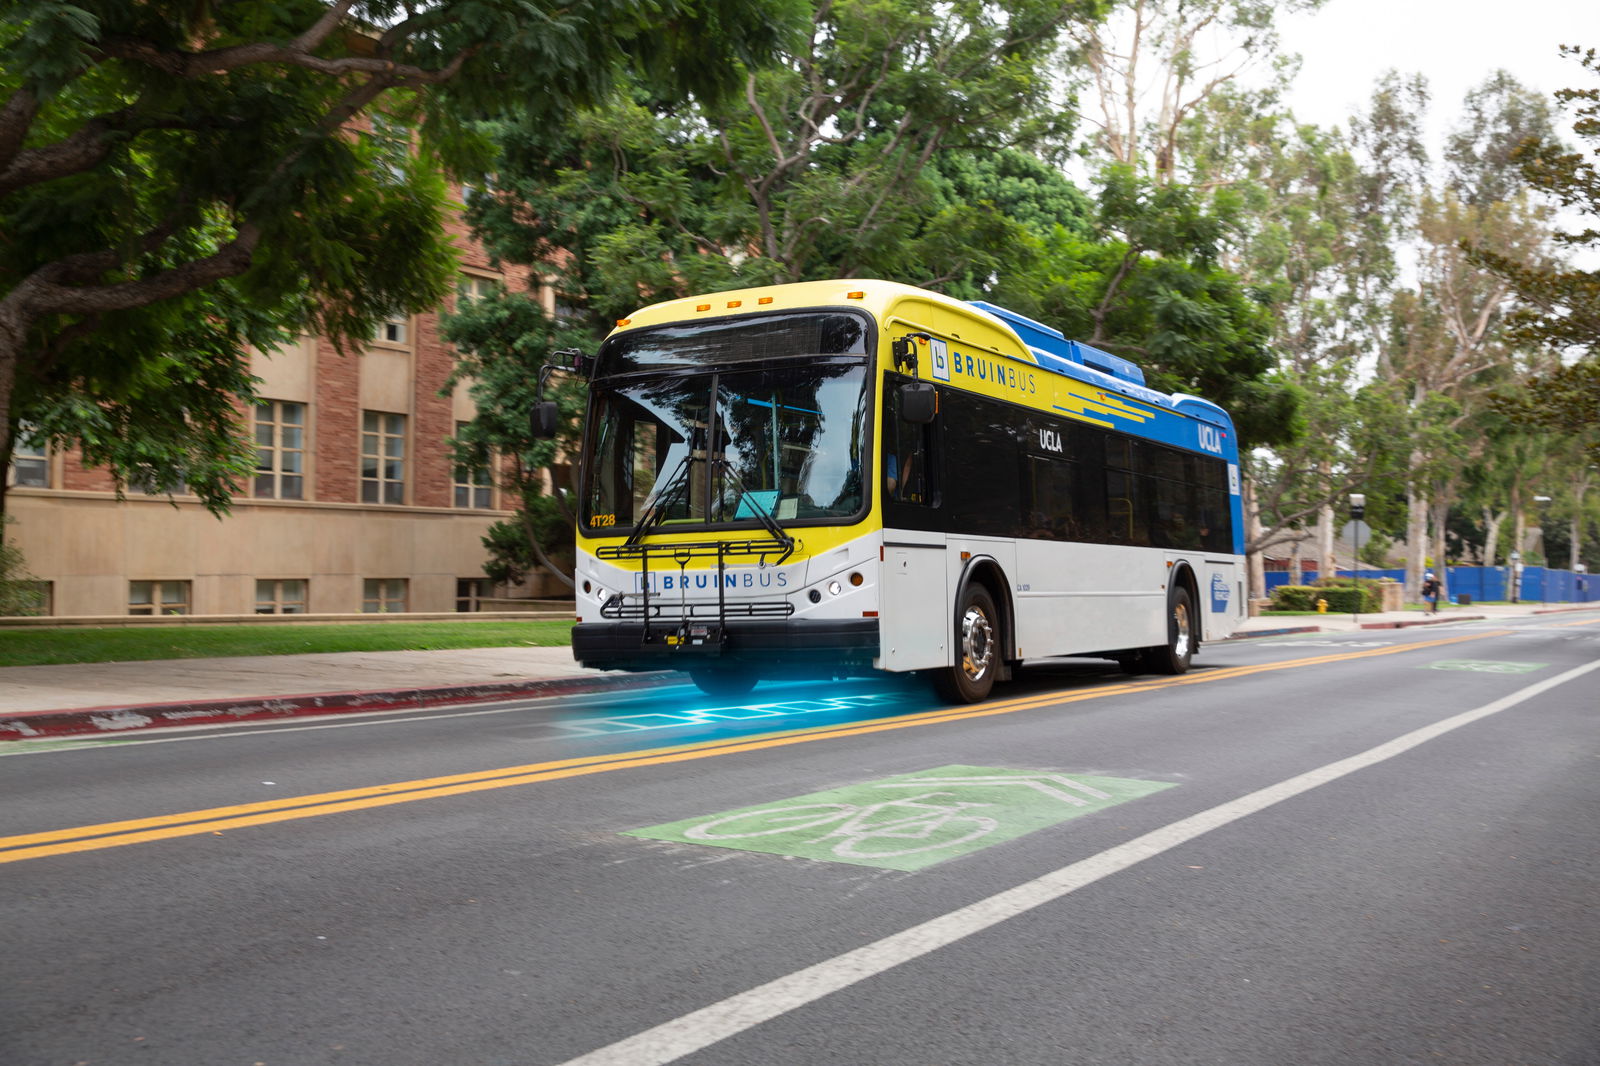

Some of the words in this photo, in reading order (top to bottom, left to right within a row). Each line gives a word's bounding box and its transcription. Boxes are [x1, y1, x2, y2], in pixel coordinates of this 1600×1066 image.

[953, 352, 1036, 394] BRUINBUS
[1040, 428, 1063, 453] UCLA
[1197, 423, 1223, 454] UCLA
[590, 513, 616, 527] 4T28
[663, 572, 787, 589] BRUINBUS
